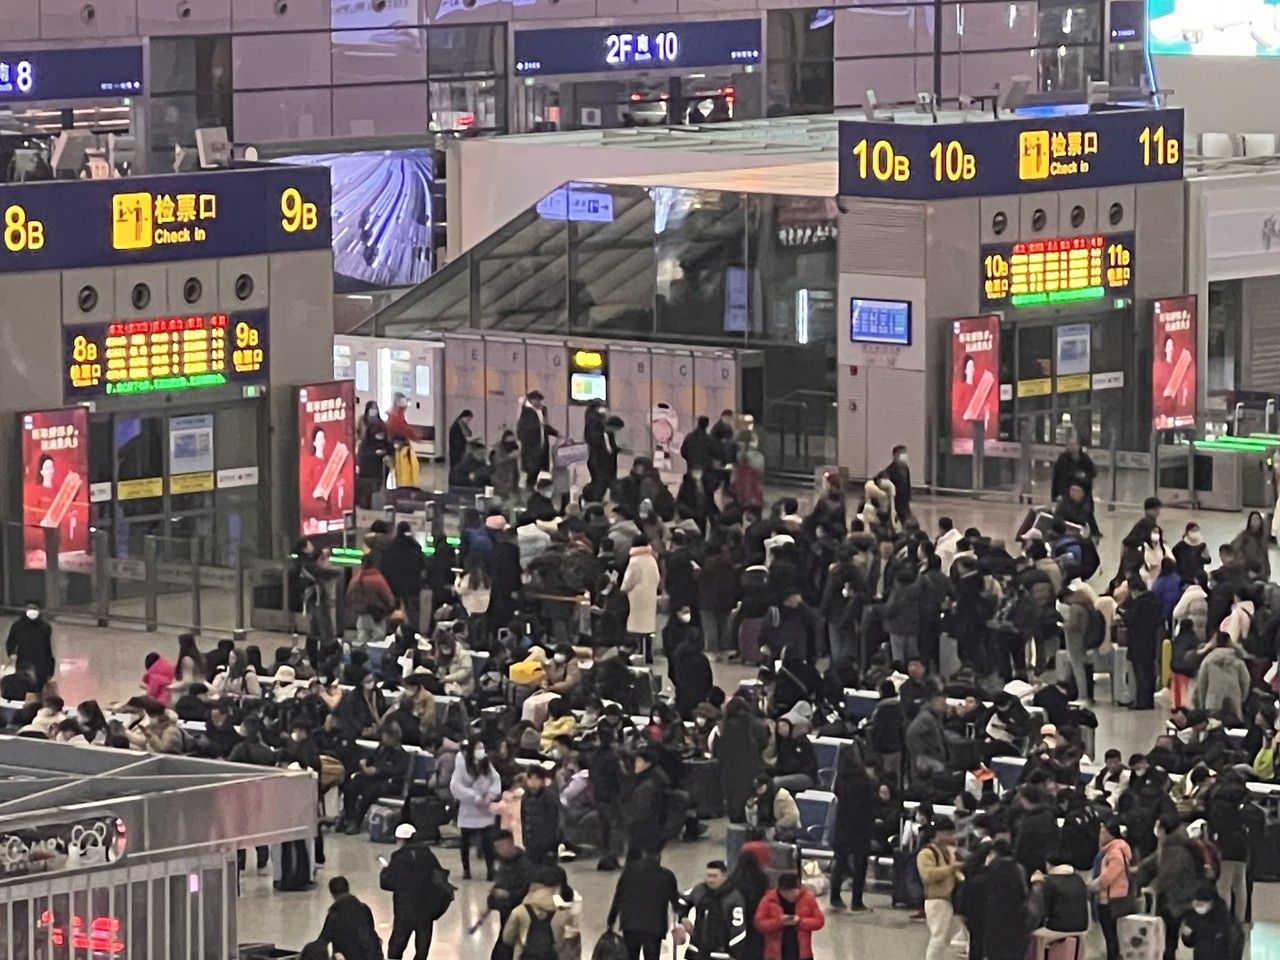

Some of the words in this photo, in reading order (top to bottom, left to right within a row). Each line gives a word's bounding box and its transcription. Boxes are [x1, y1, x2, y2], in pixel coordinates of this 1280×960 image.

[656, 31, 678, 61] 10
[17, 60, 32, 92] 8
[852, 138, 911, 182] 10B
[930, 140, 977, 182] 10B
[1050, 131, 1098, 158] 检票口
[1138, 125, 1179, 167] 11B
[154, 193, 217, 225] 检票口
[280, 187, 318, 233] 9B
[4, 205, 44, 252] 8B
[154, 228, 191, 246] Check
